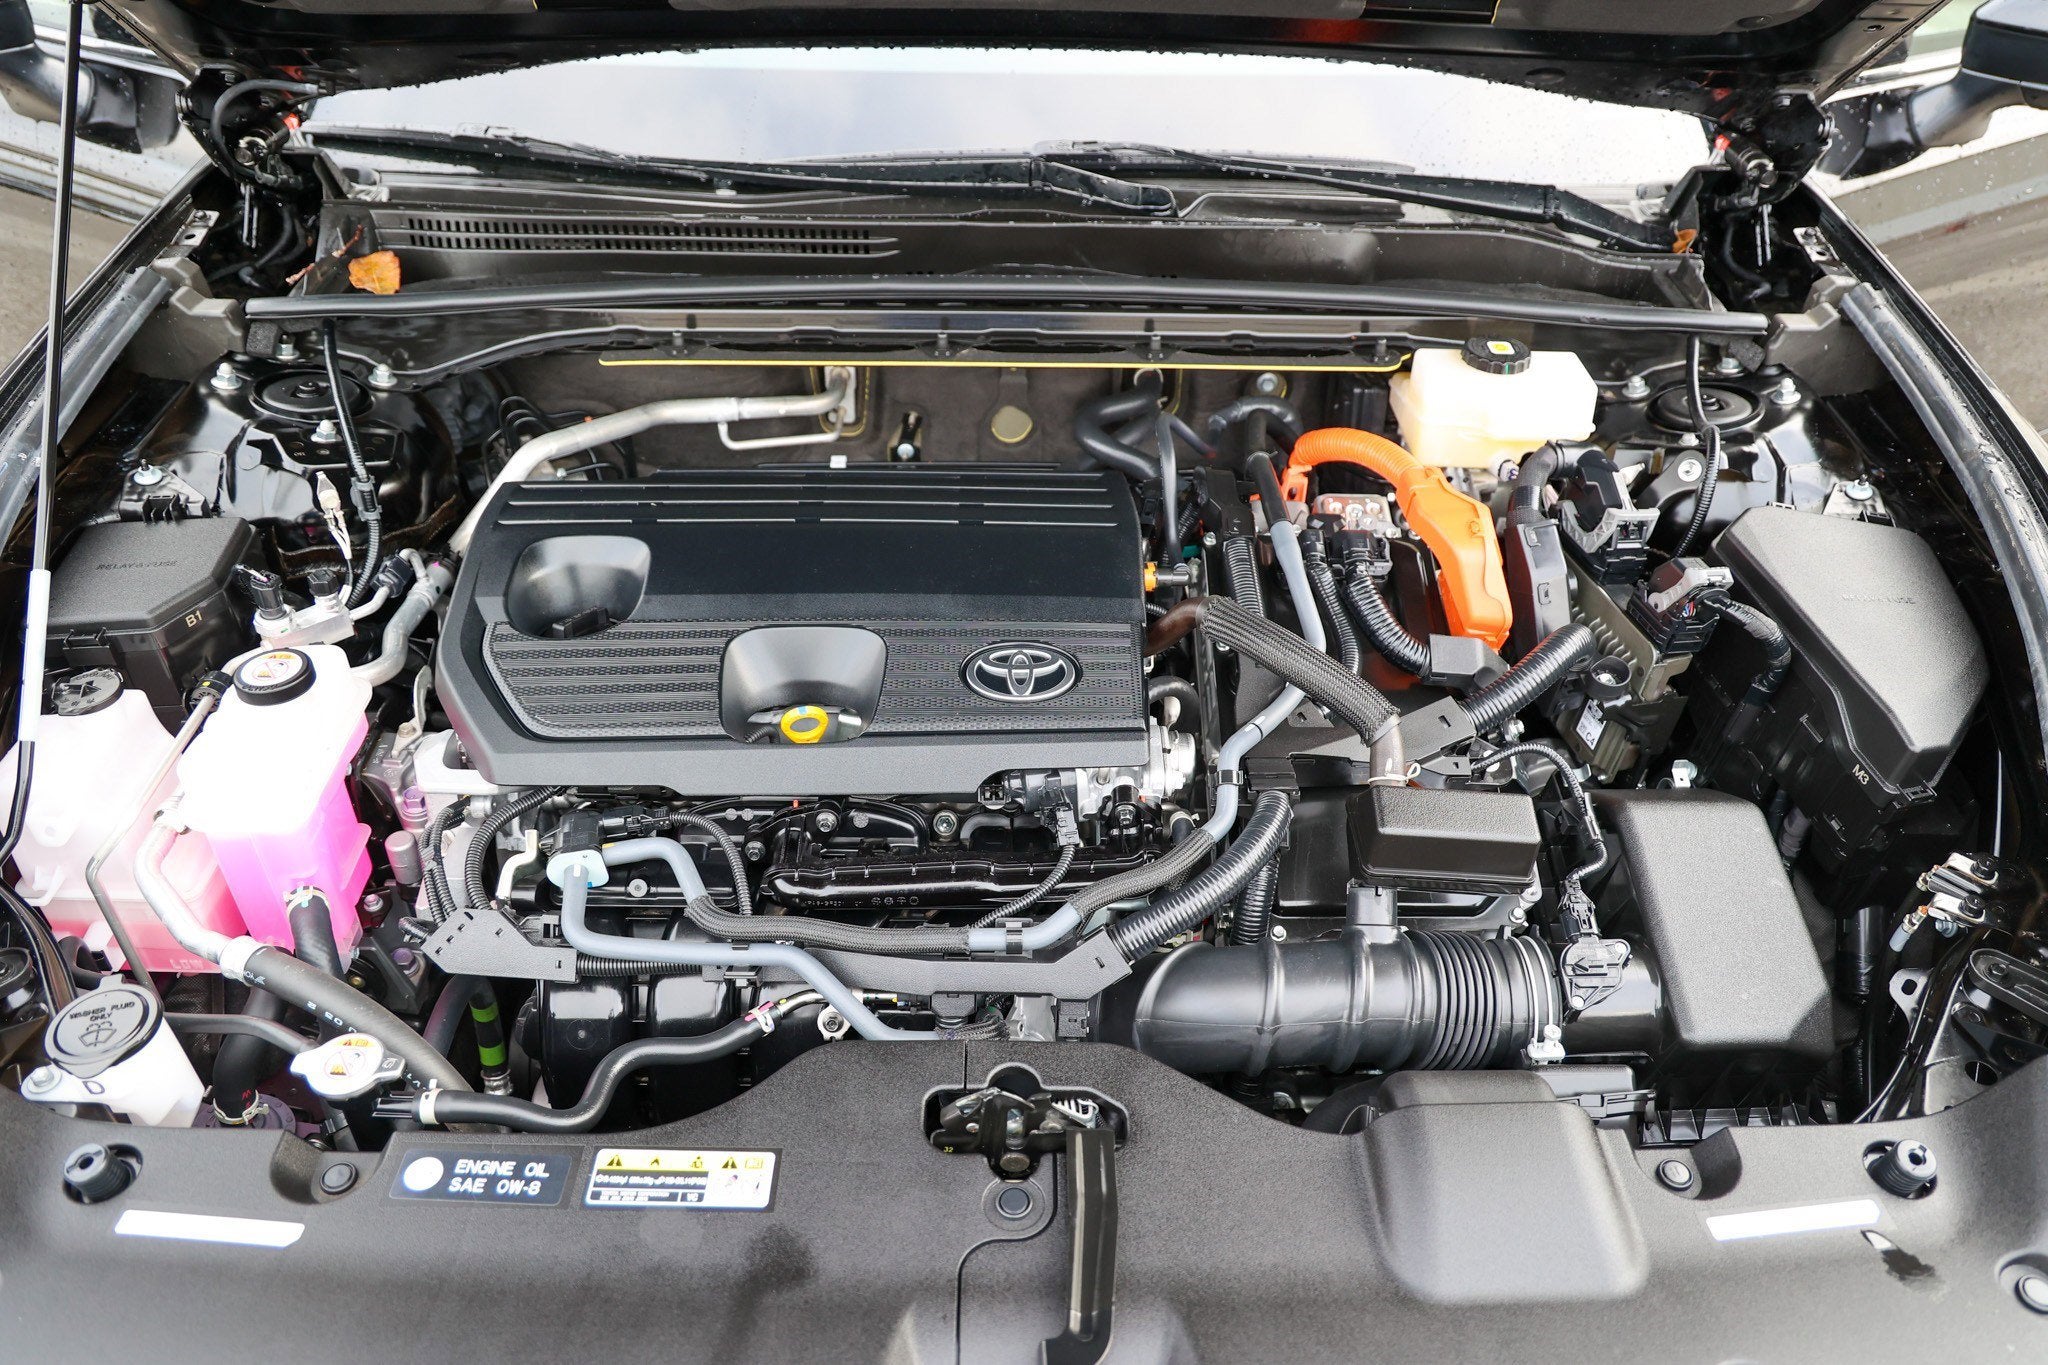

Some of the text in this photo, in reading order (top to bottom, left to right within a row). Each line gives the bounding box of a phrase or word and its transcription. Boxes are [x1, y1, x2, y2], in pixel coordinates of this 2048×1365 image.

[185, 610, 203, 628] B1
[1852, 763, 1870, 785] M3
[70, 1001, 135, 1019] WASHER FLUID
[89, 1012, 112, 1022] ONLY
[454, 1159, 550, 1178] ENGINE OIL
[448, 1177, 488, 1193] SAE
